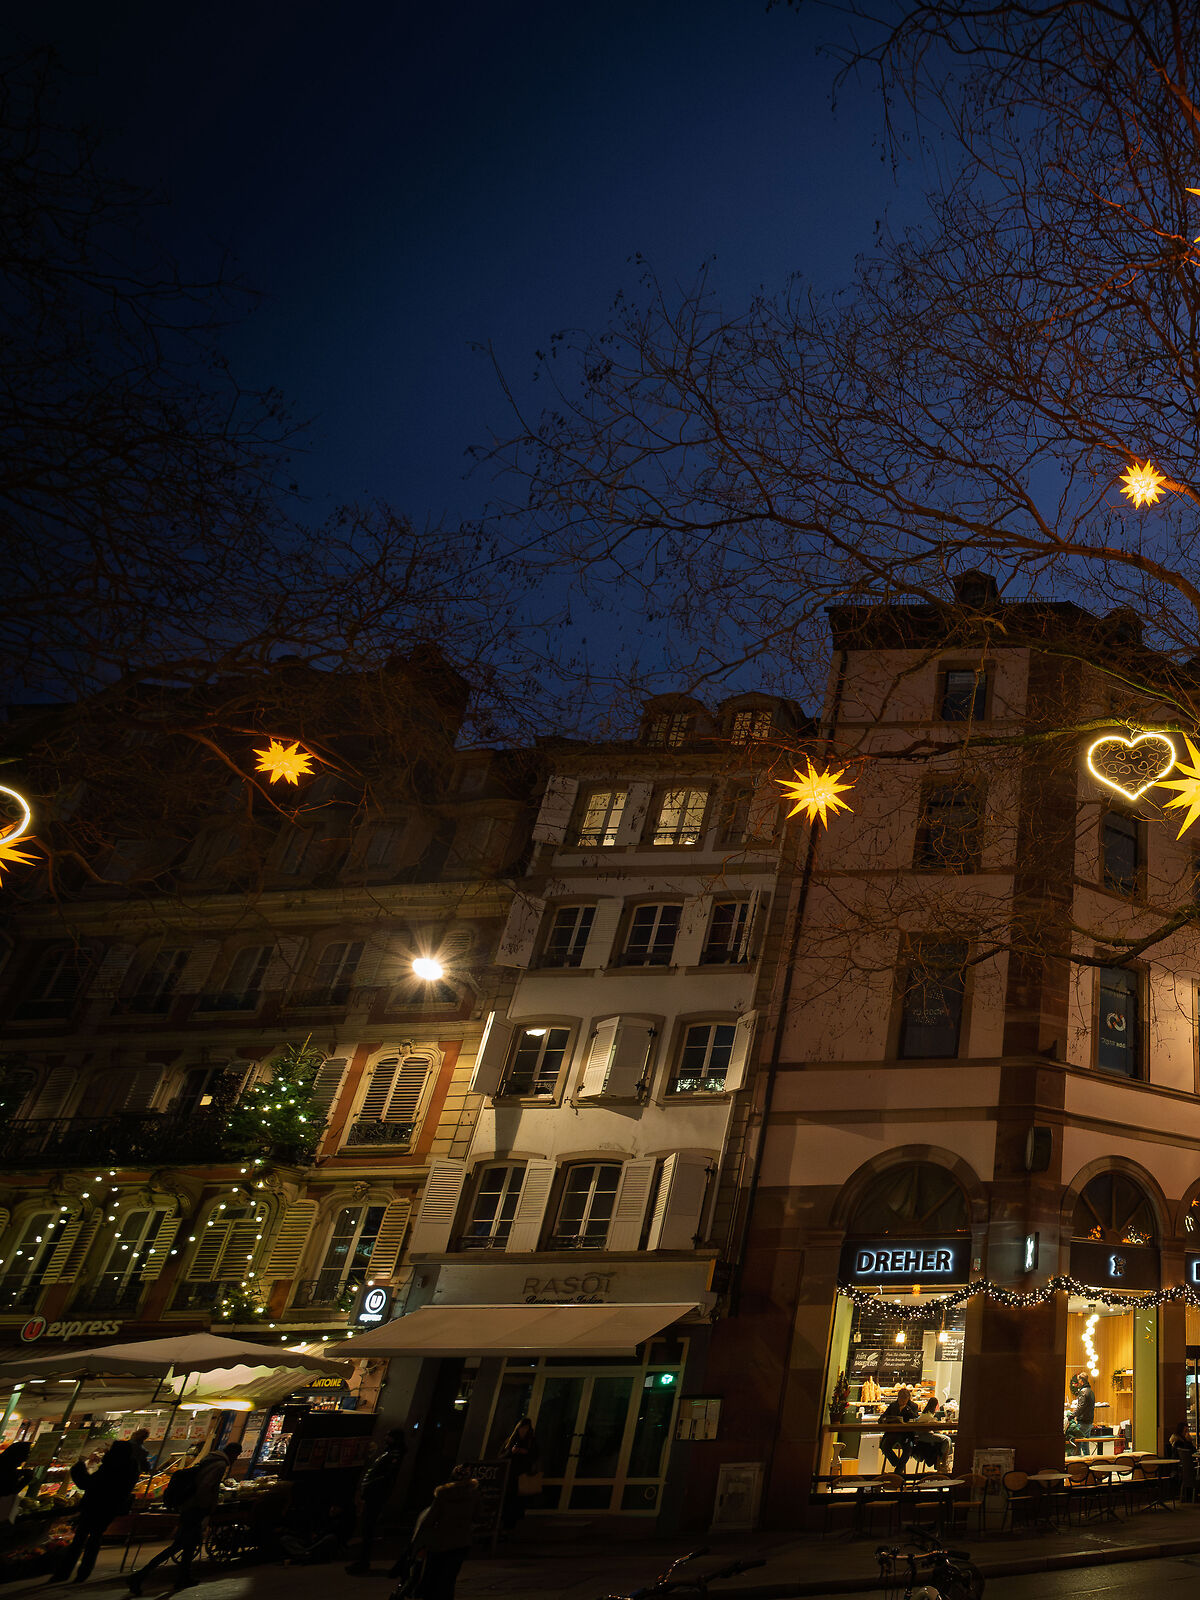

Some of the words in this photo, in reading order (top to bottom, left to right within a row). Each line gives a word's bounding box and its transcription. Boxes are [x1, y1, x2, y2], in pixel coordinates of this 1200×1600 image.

[856, 1250, 952, 1273] DREHER
[22, 1319, 44, 1340] U
[47, 1320, 123, 1341] express
[312, 1378, 342, 1388] ANTOINE
